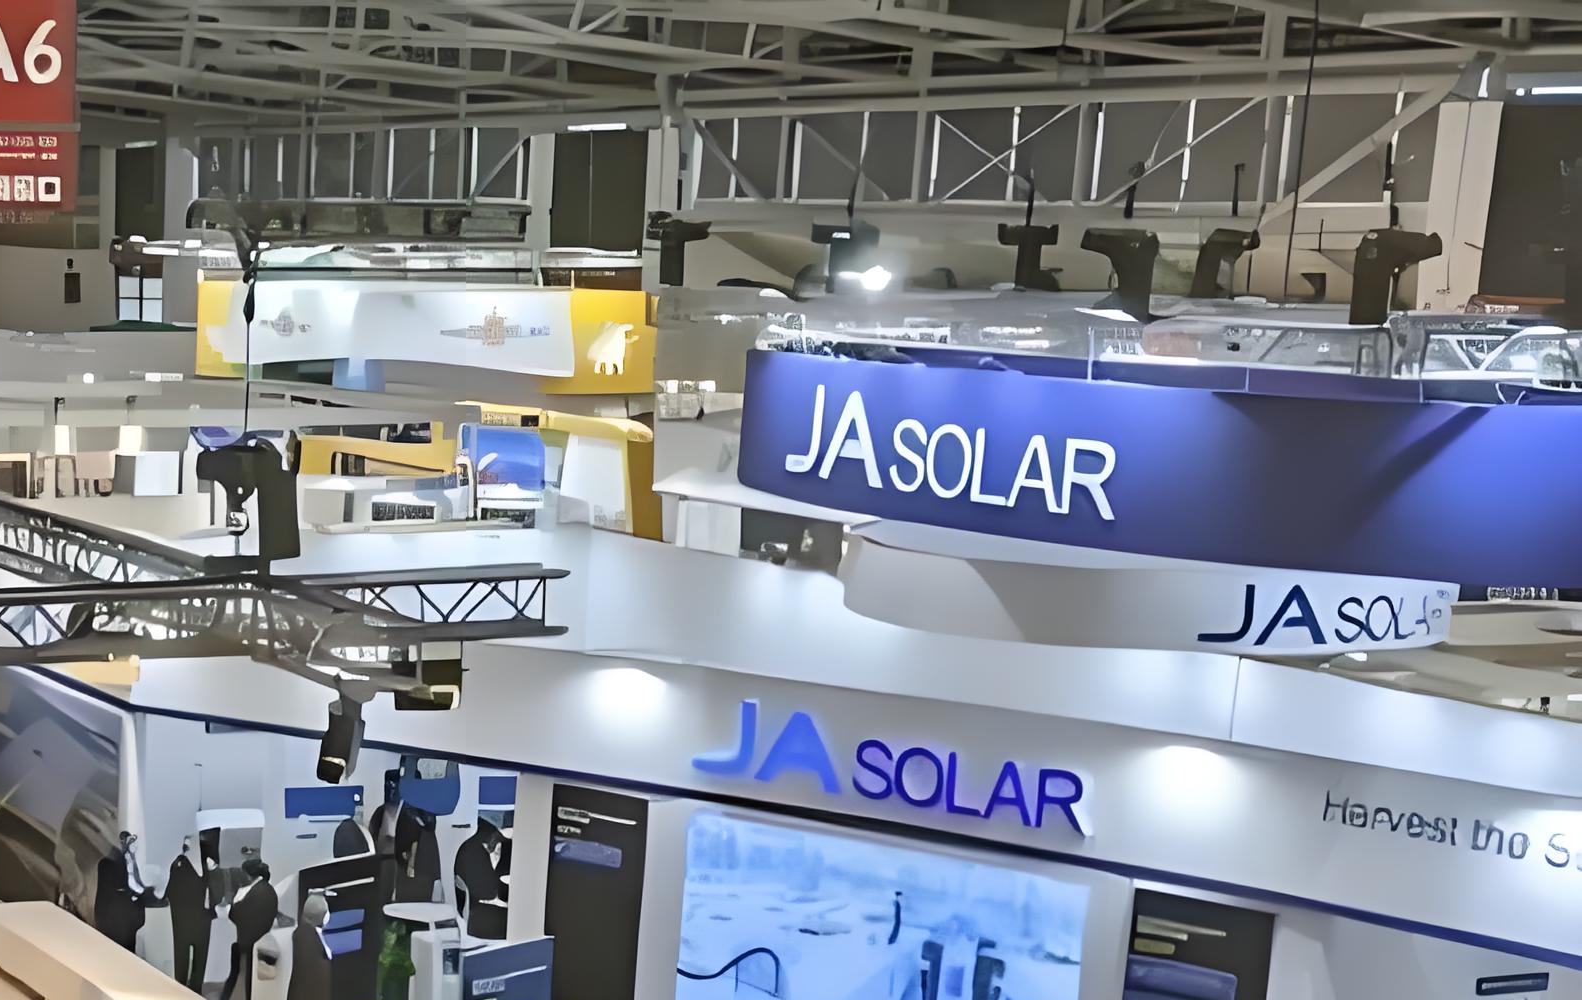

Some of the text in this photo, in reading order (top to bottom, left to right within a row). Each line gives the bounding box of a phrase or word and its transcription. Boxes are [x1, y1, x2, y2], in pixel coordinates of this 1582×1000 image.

[785, 384, 1116, 521] JA SOLAR
[1197, 584, 1328, 646] JA
[691, 699, 1095, 838] JA SOLAR
